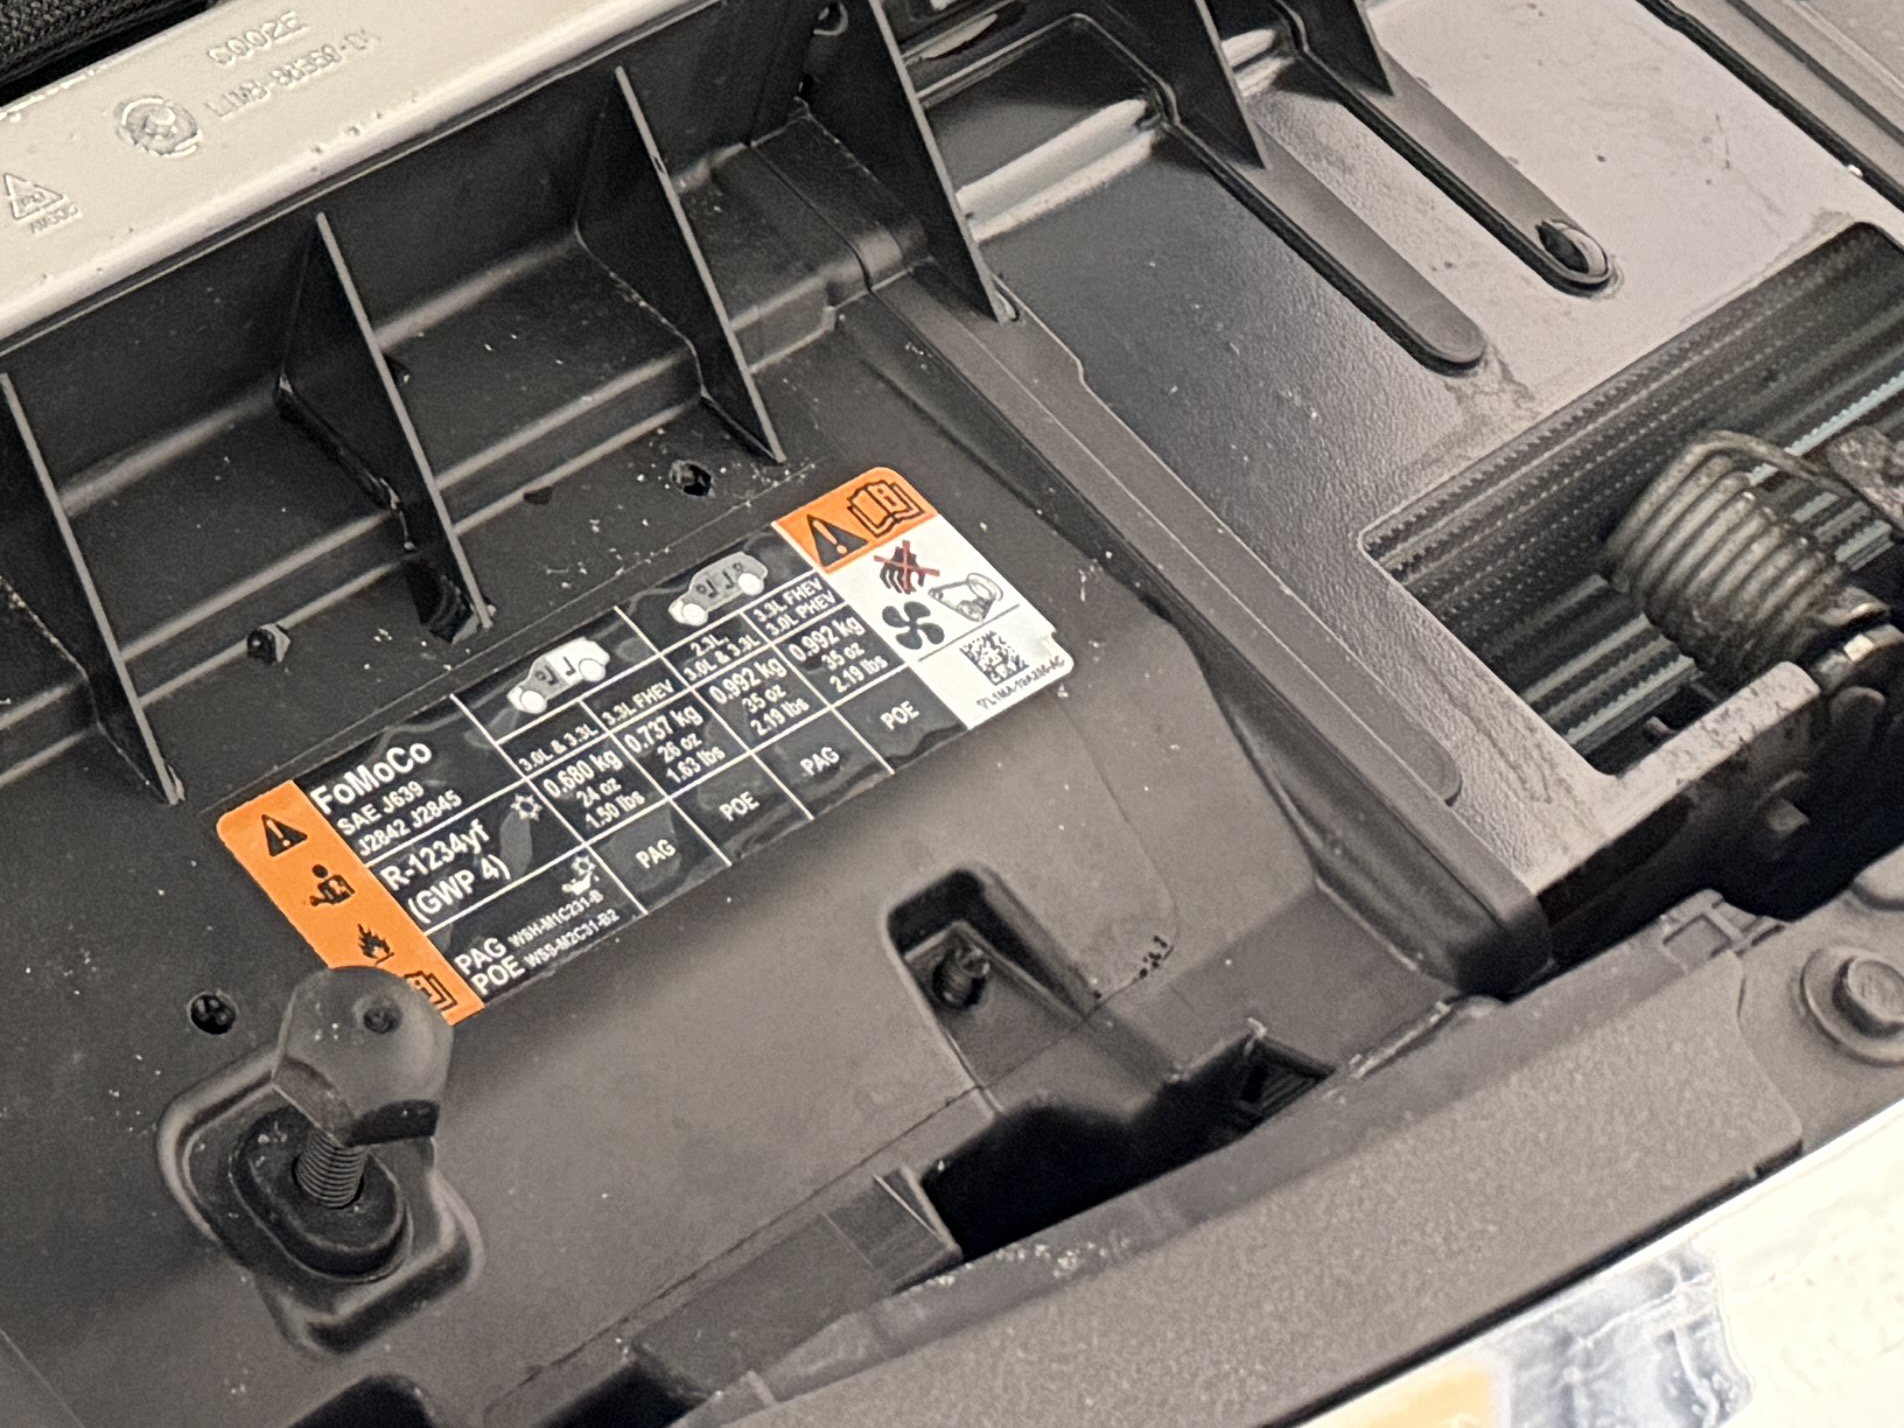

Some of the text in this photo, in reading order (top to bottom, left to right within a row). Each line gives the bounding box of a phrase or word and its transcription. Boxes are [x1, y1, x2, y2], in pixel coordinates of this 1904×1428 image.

[753, 577, 822, 622] 3.3L FHEV
[765, 589, 835, 636] 3.0L PHEV
[683, 633, 761, 681] 3.0L & 3.3L
[788, 616, 865, 661] 0.992 kg
[821, 642, 865, 670] 35 oz
[709, 657, 787, 704] 0.992 kg
[829, 655, 887, 693] 2.19 lbs
[601, 679, 673, 725] 3.3L FHEV
[741, 684, 786, 713] 35 oz
[749, 697, 809, 736] 2.19 lbs
[880, 700, 919, 729] POE
[518, 723, 598, 771] 3.0L & 3.3L
[623, 705, 703, 753] 0.737 kg
[657, 732, 702, 762] 26 oz
[309, 743, 431, 814] FoMoCo
[543, 749, 623, 797] 0.680 kg
[666, 746, 725, 783] 1.63 lbs
[799, 746, 839, 775] PAG
[336, 780, 423, 835] SAE J639
[575, 777, 621, 808] 24 oz
[585, 790, 645, 828] 1.50 lbs
[718, 790, 759, 820] POE
[358, 789, 461, 856] J2842 J2845
[379, 818, 489, 890] R-1234yf
[635, 839, 675, 868] PAG
[407, 854, 511, 924] (GWP 4)
[454, 889, 603, 974] PAG WSH-M1C231-B
[470, 954, 524, 995] POE
